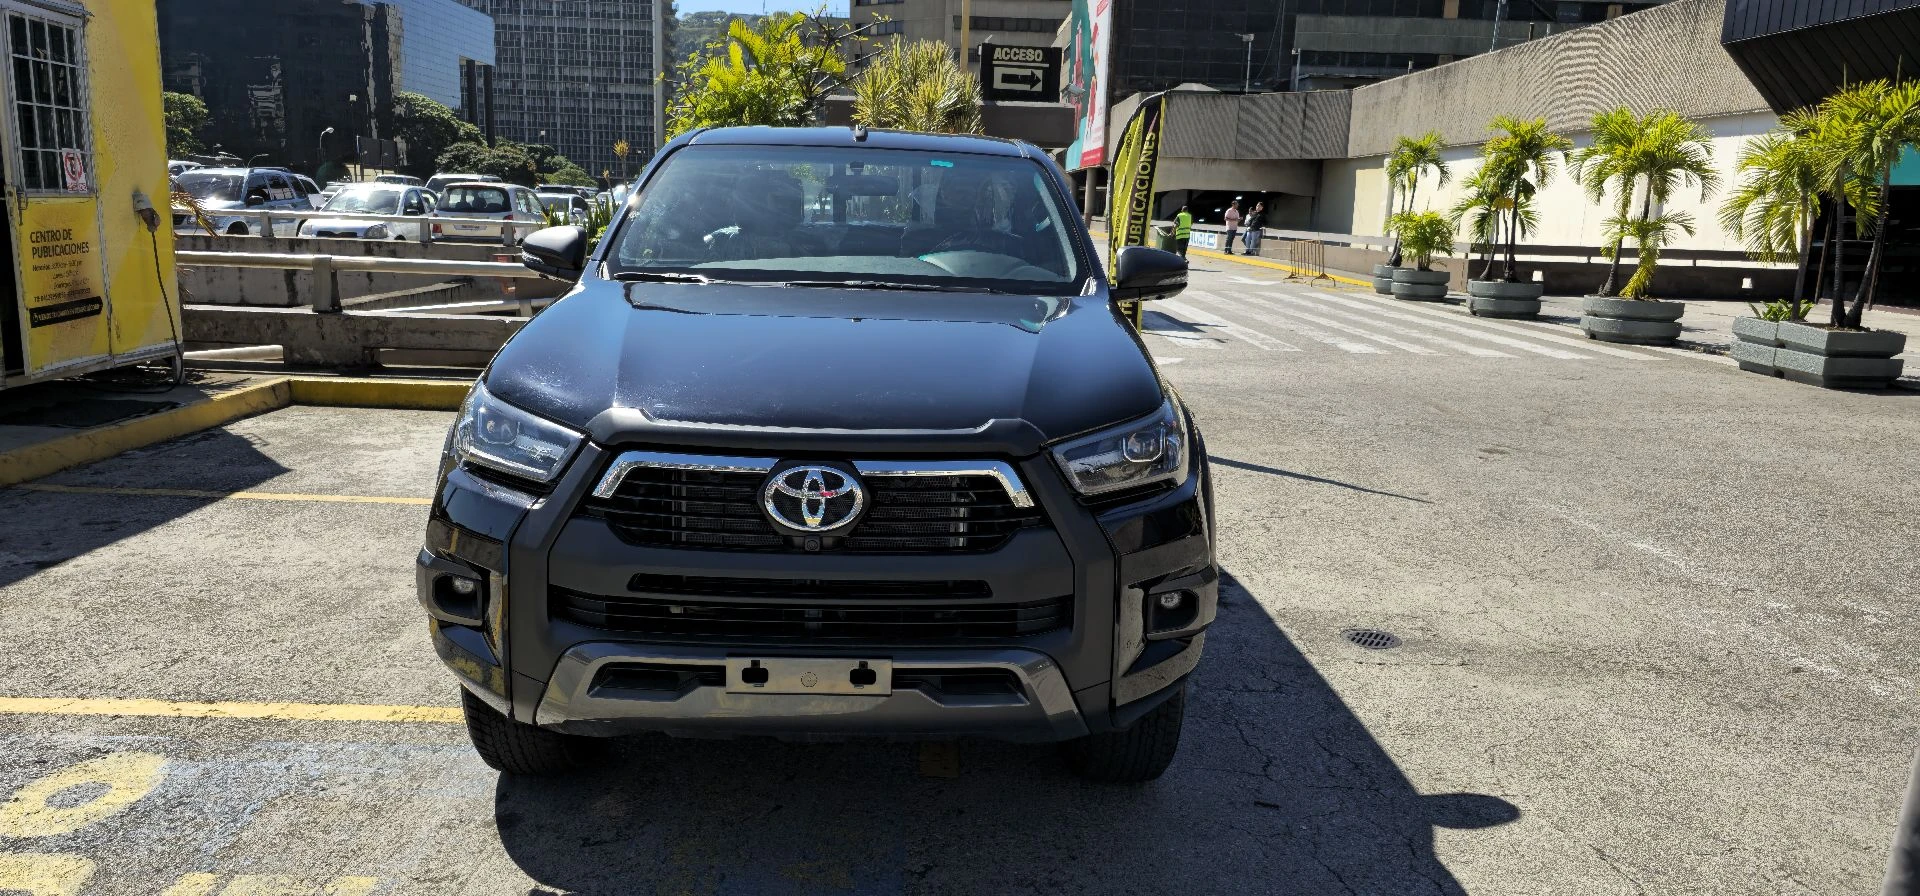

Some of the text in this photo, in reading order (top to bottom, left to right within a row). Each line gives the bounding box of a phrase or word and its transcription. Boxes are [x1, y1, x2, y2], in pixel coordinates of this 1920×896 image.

[993, 47, 1043, 62] ACCESO
[1127, 131, 1156, 246] UBLICACIONES
[30, 229, 73, 243] CENTRO DE
[32, 242, 89, 259] PUBLICACIONES
